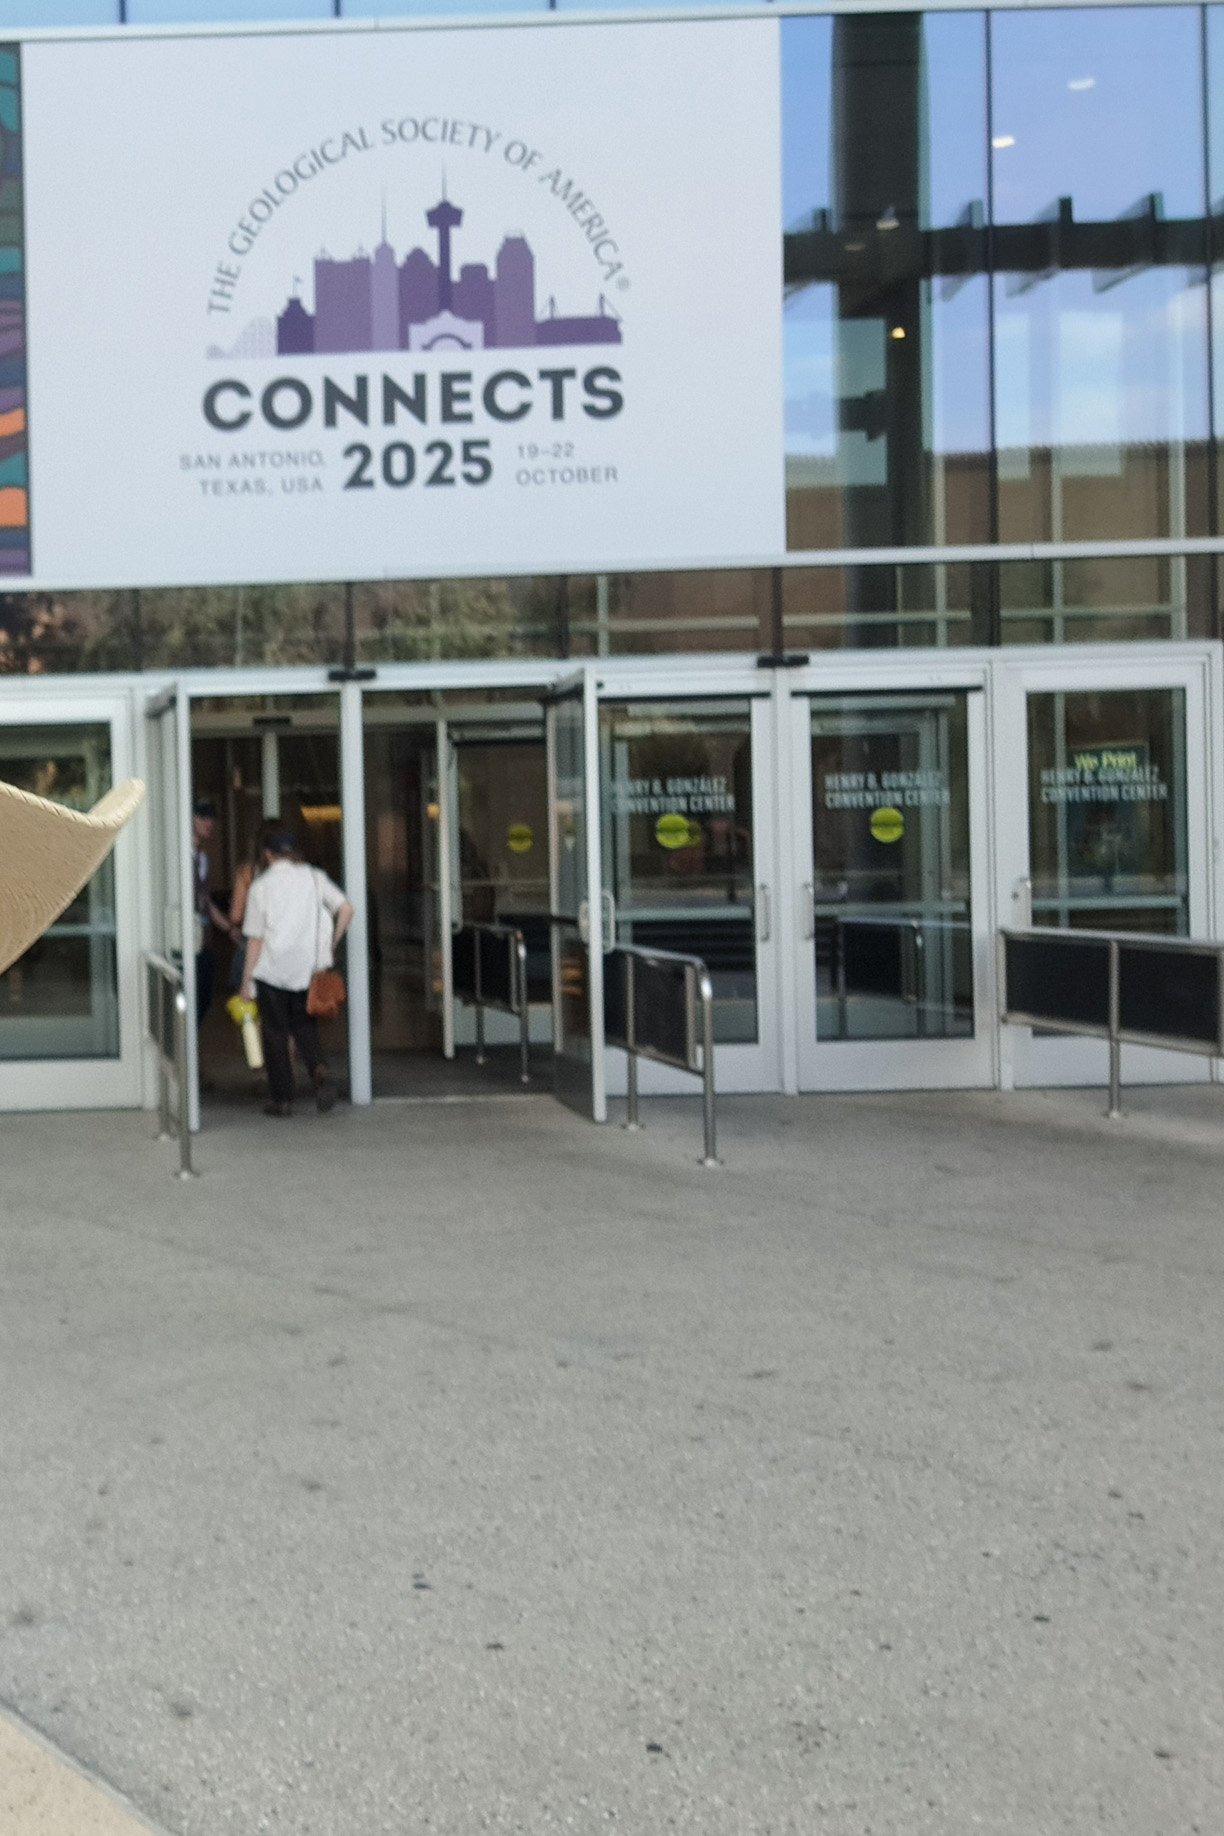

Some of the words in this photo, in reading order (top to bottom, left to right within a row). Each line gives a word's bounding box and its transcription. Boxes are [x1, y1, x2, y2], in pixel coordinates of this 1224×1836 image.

[206, 262, 242, 316] THE
[227, 126, 375, 257] GEOLOGICAL
[380, 117, 502, 154] SOCIETY
[503, 139, 544, 171] OF
[203, 366, 624, 432] CONNECTS
[178, 453, 222, 471] SAN
[342, 438, 493, 491] 2025
[515, 464, 619, 486] OCTOBER
[280, 475, 324, 494] USA
